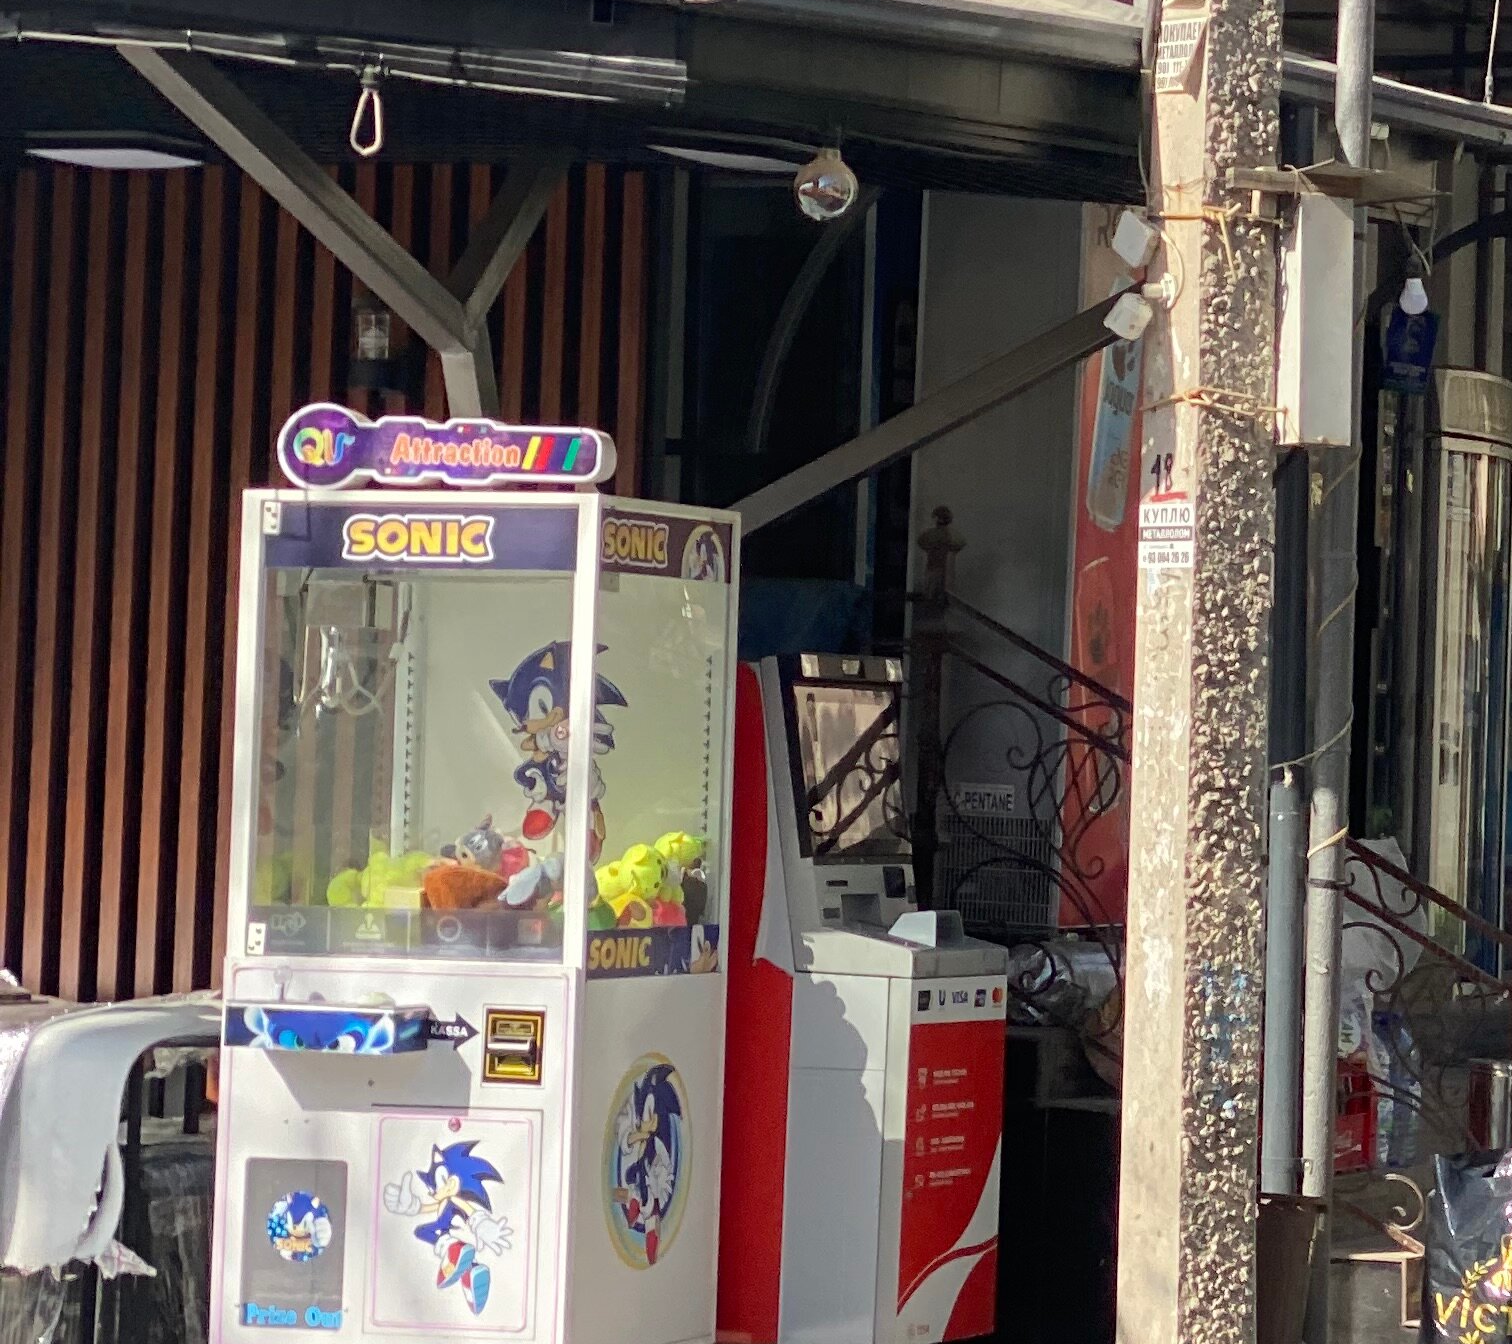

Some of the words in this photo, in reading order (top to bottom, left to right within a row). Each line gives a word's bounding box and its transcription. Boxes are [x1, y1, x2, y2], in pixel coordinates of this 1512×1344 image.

[390, 432, 521, 467] Attraction
[1143, 507, 1191, 524] КУПЛЮ
[347, 519, 491, 558] SONIC
[602, 520, 667, 564] SONIC
[588, 937, 652, 970] SONIC
[430, 1022, 468, 1037] KASSA
[246, 1302, 298, 1326] Prize
